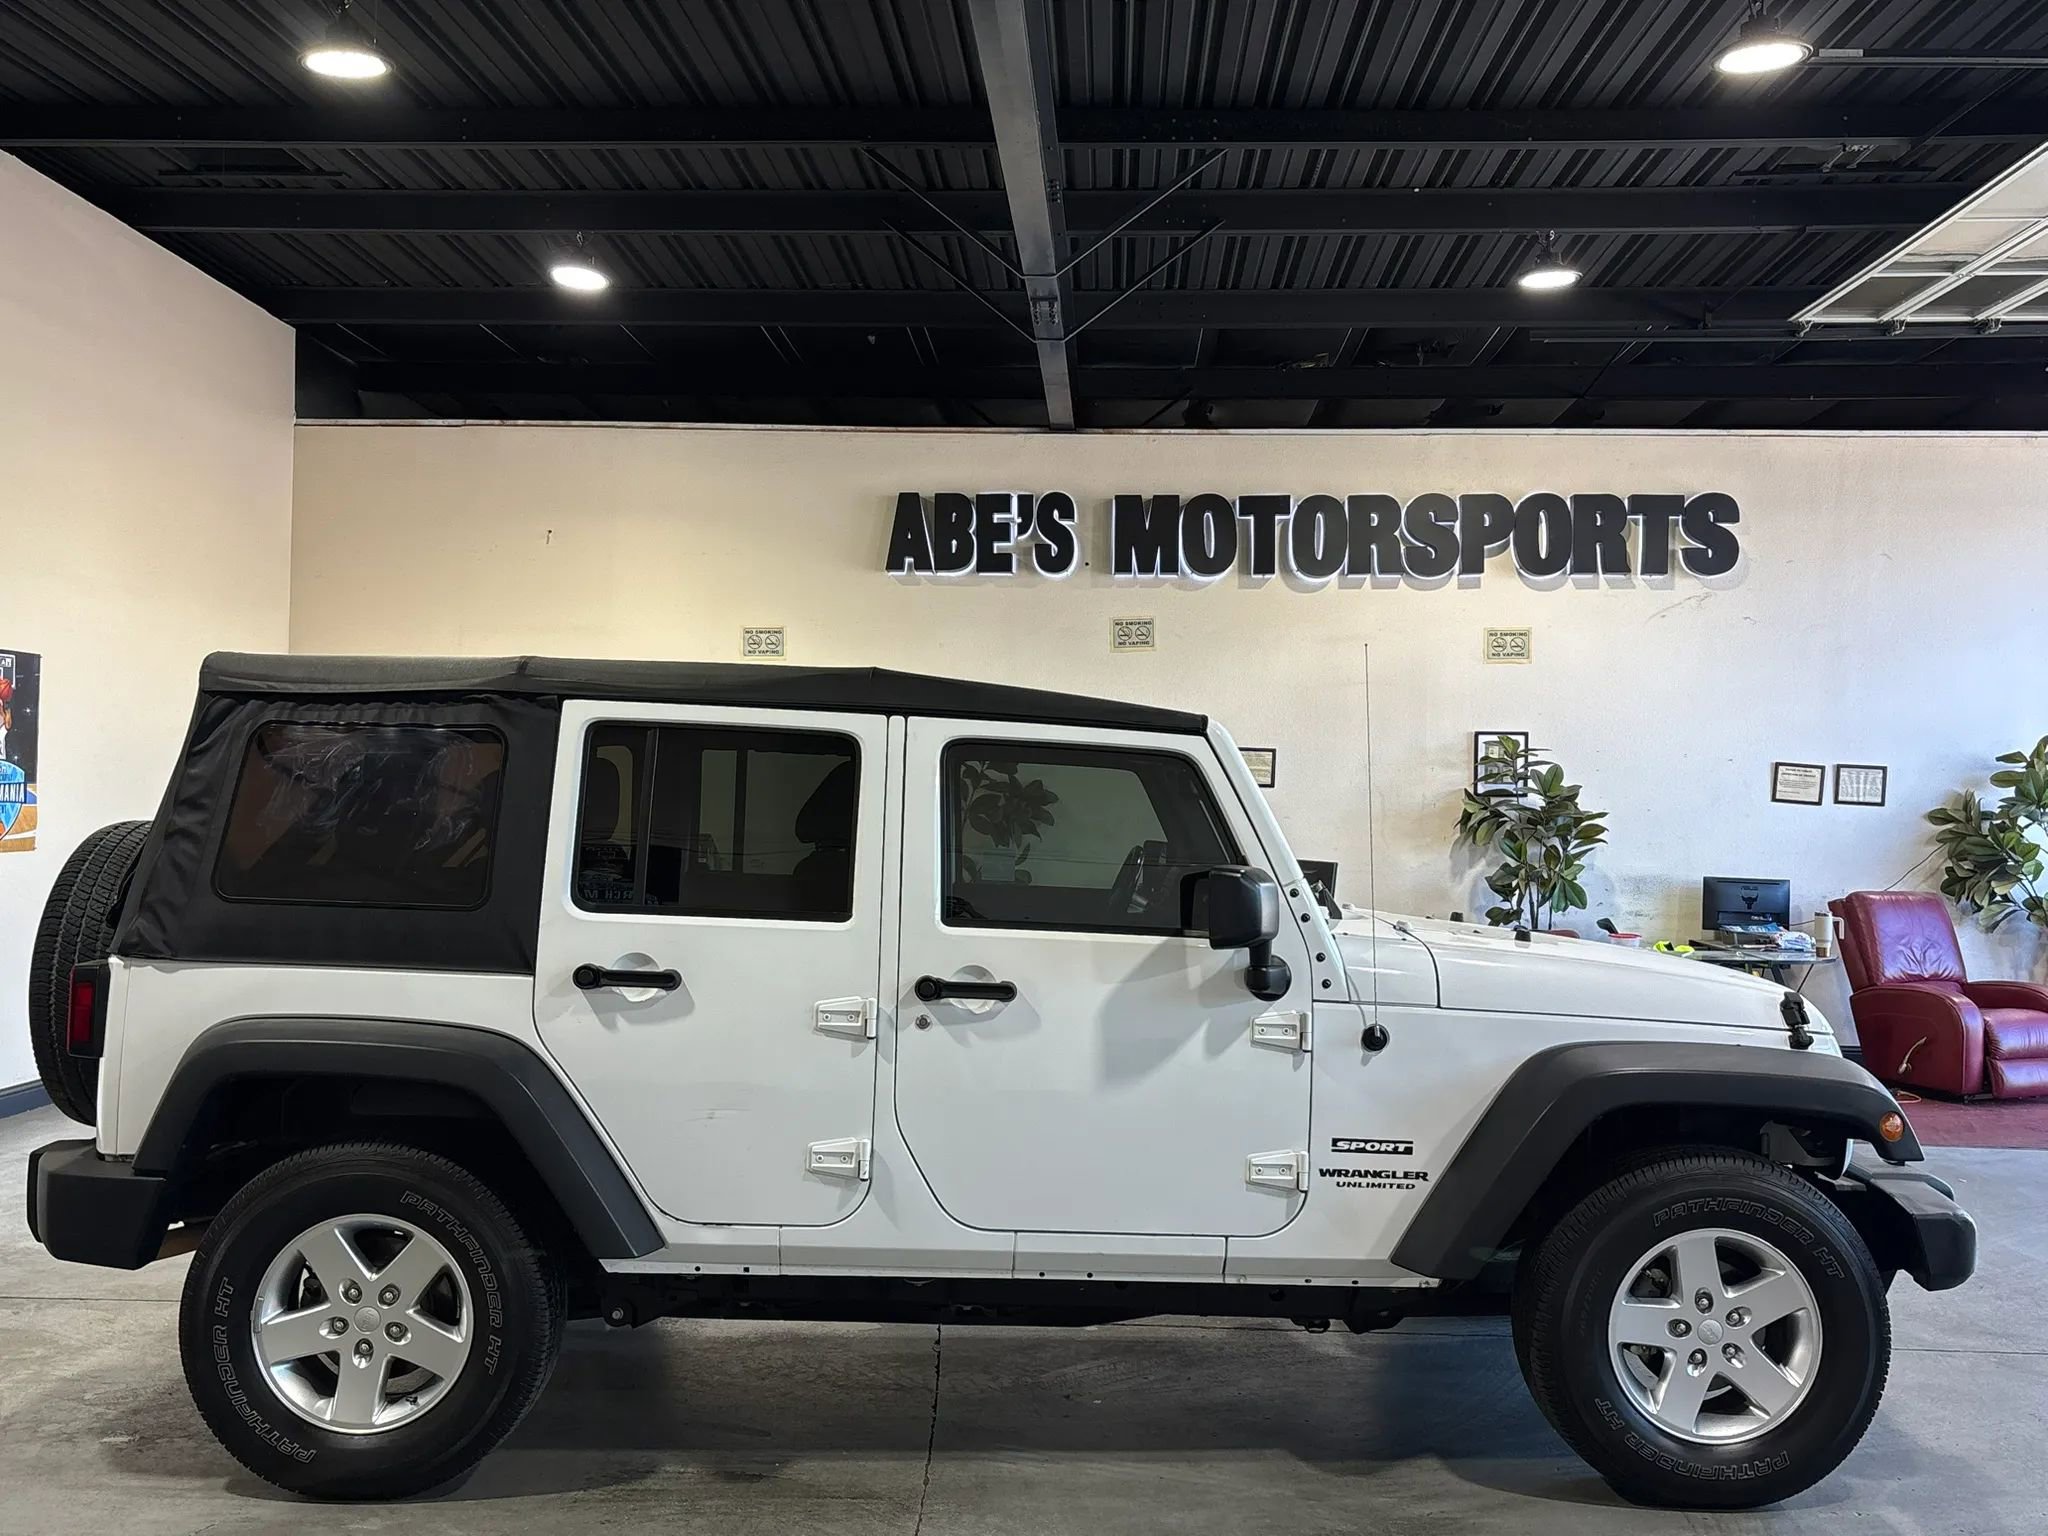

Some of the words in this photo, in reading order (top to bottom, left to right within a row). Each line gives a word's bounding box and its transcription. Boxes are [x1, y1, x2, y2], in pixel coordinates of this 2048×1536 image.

[885, 491, 1077, 575] ABE'S
[1113, 491, 1741, 577] MOTORSPORTS
[1335, 1140, 1411, 1152] SPORT
[1319, 1168, 1429, 1181] WRANGLER
[1336, 1181, 1416, 1190] UNLIMITED
[1653, 1197, 1815, 1246] PATHFINDER
[1813, 1246, 1847, 1280] HT
[214, 1277, 236, 1318] HT
[401, 1190, 502, 1328] PATHFINDER
[483, 1335, 502, 1375] HT
[213, 1324, 321, 1464] PATHFINDER
[1594, 1397, 1625, 1431] HT
[1624, 1432, 1791, 1480] PATHFINDER
